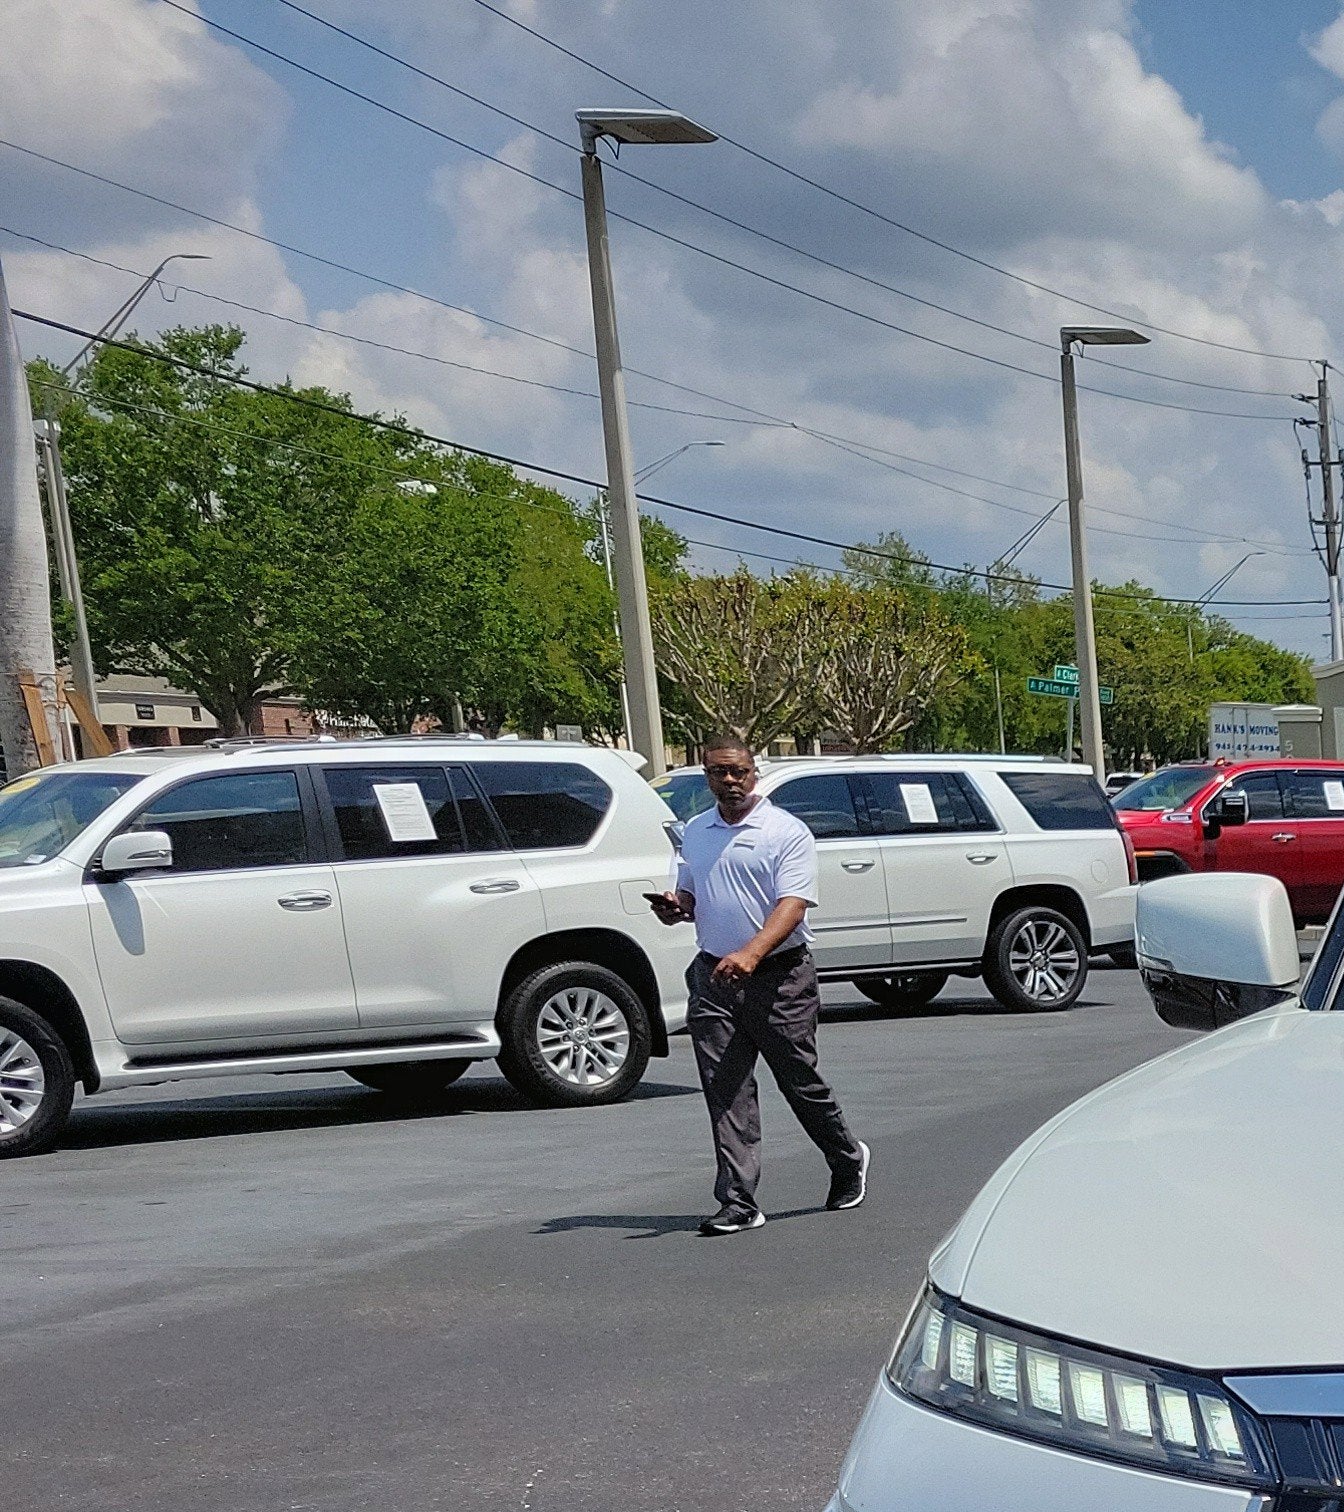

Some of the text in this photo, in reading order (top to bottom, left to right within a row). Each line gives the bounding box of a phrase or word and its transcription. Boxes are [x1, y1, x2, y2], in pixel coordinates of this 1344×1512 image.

[1038, 681, 1069, 694] Palmer
[1215, 723, 1279, 737] HANK'S MOVING
